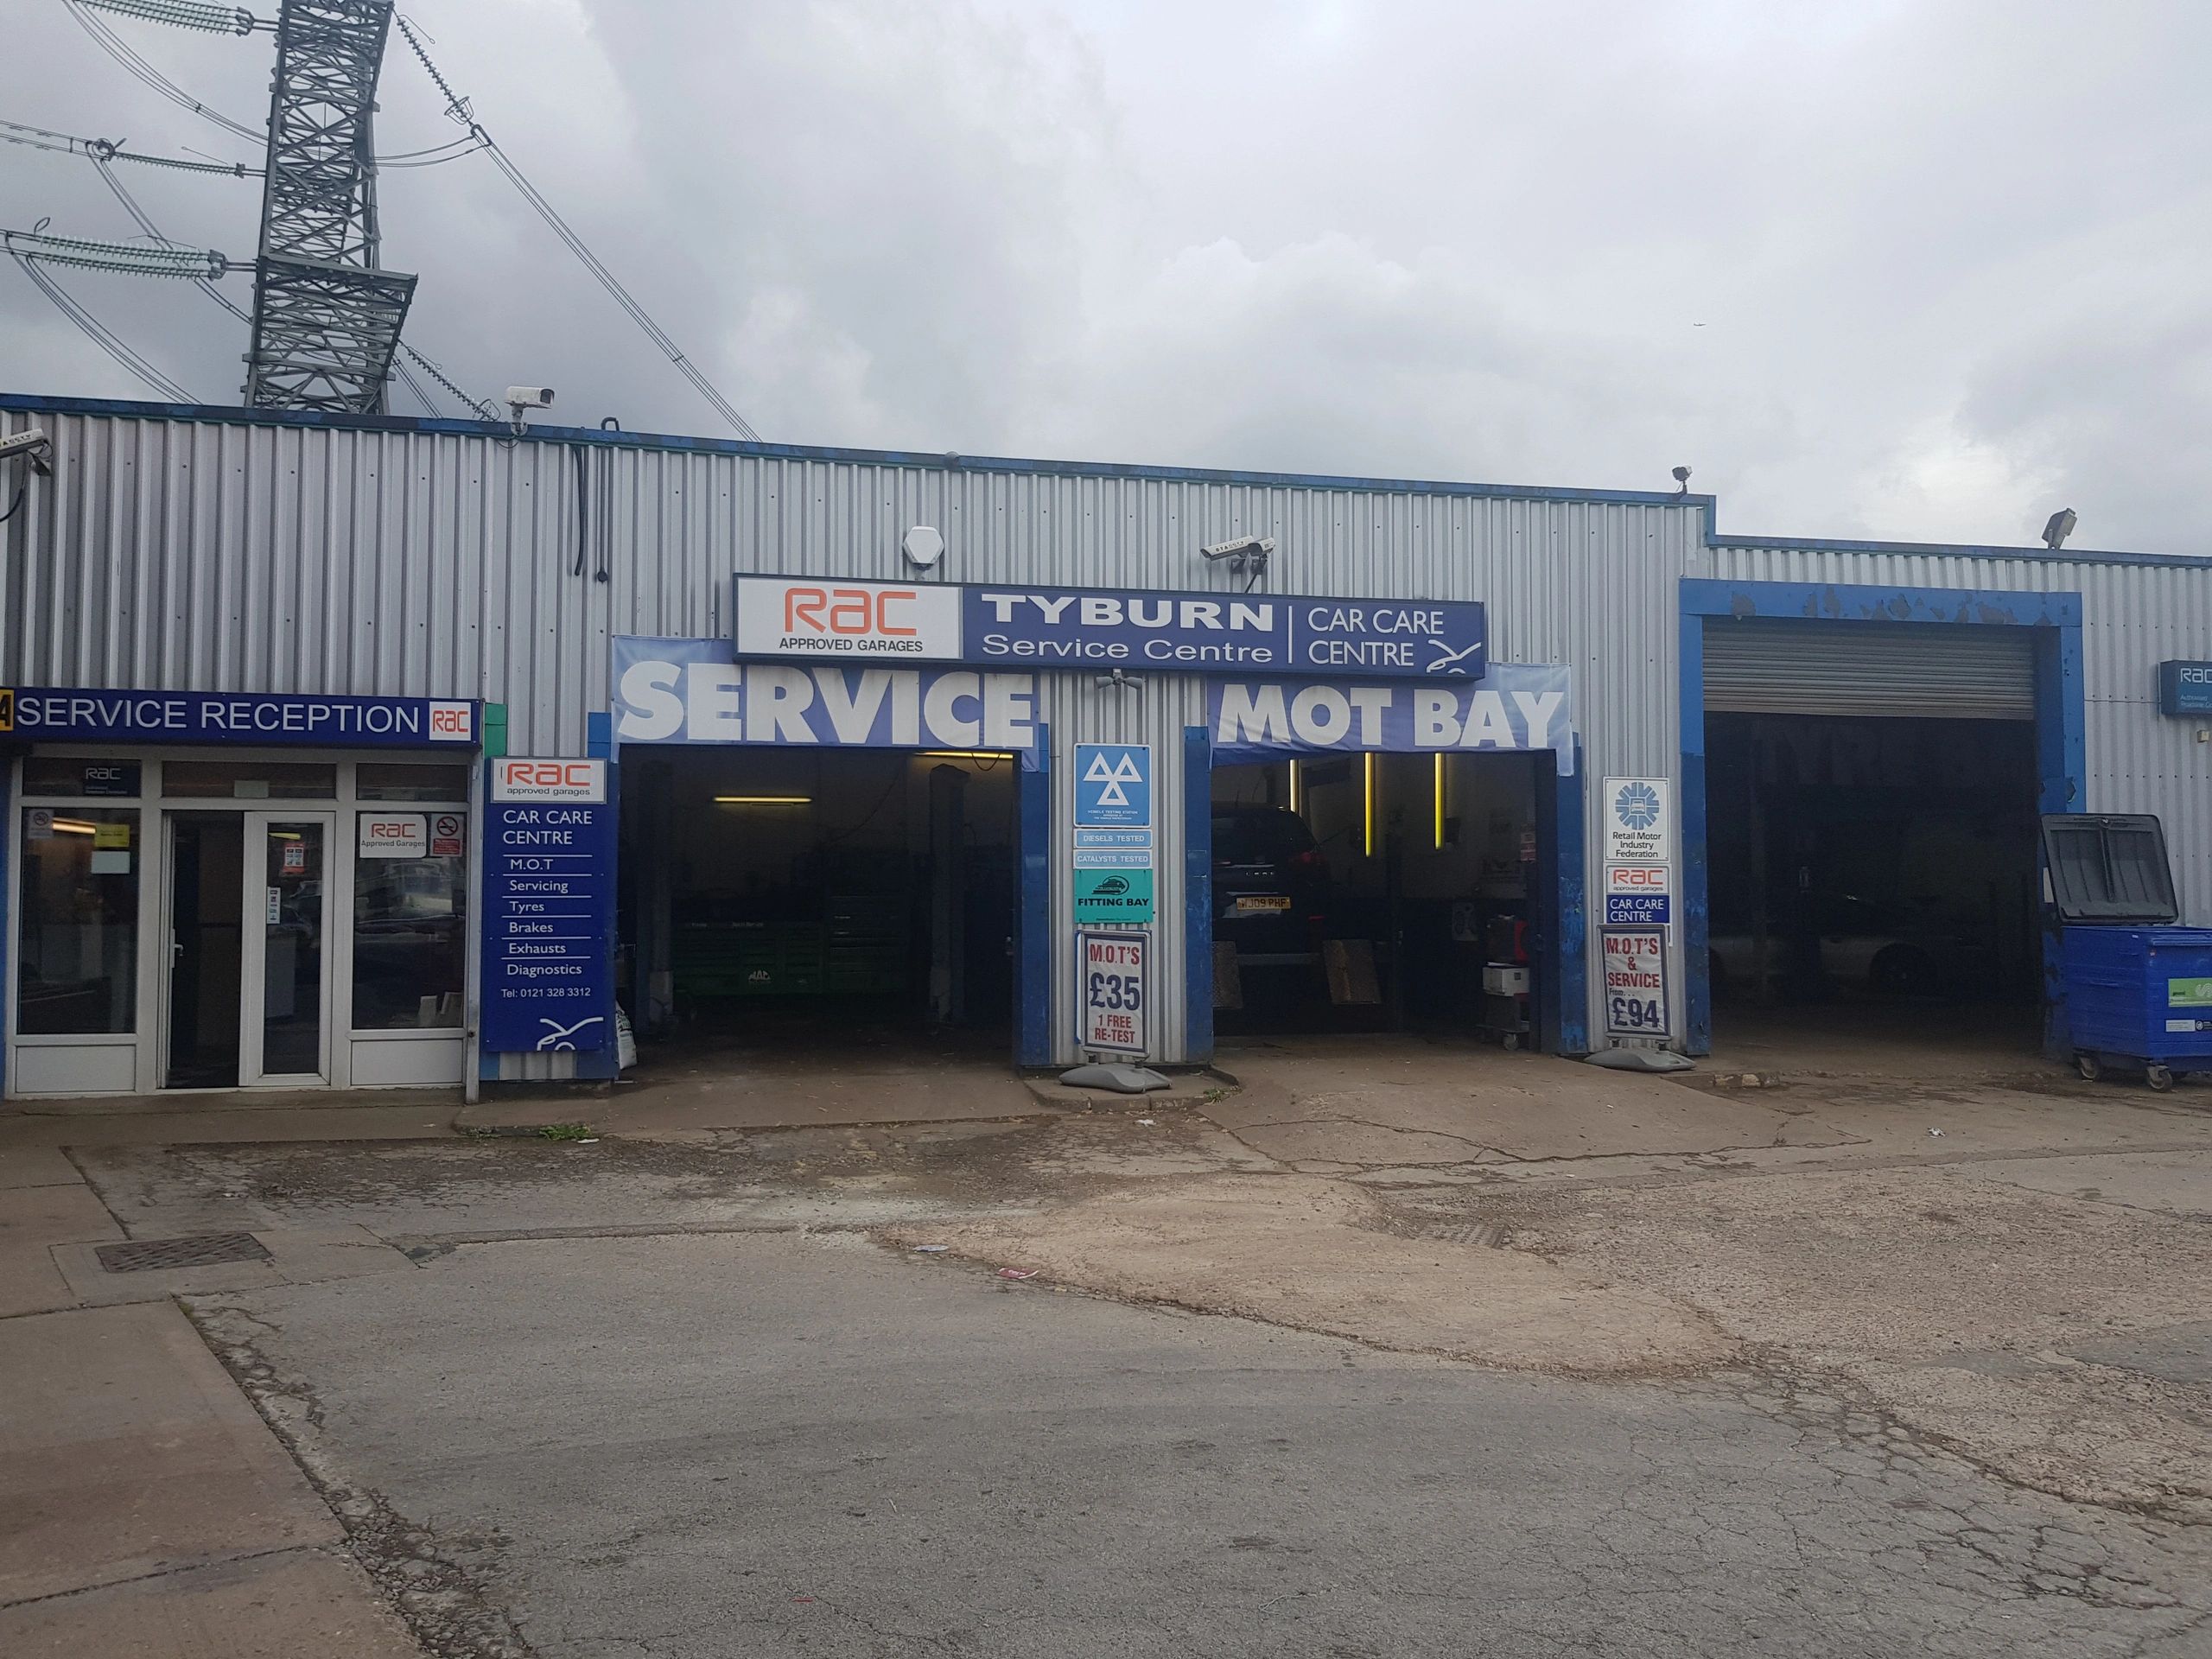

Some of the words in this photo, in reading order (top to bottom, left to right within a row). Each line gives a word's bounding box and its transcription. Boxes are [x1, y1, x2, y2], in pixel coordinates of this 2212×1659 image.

[982, 594, 1273, 632] TYBURN
[1308, 607, 1367, 632] CAR
[1372, 609, 1444, 634] CARE
[779, 638, 853, 651] APPROVED
[857, 639, 924, 652] GARAGES
[982, 634, 1129, 658] Service
[1144, 639, 1273, 663] Centre
[1308, 640, 1414, 666] CENTRE
[618, 660, 1034, 748] SERVICE
[16, 697, 188, 728] SERVICE
[200, 701, 419, 734] RECEPTION
[1217, 683, 1392, 747] MOT
[1414, 690, 1564, 748] BAY
[503, 810, 541, 823] CAR
[546, 810, 593, 824] CARE
[503, 830, 573, 844] CENTRE
[1612, 831, 1636, 840] Retail
[1637, 832, 1662, 841] Motor
[396, 840, 426, 849] Garages
[1620, 841, 1654, 850] Industry
[510, 859, 554, 870] M.O.T
[510, 880, 569, 893] Servicing
[509, 901, 545, 914] Tyres
[1610, 899, 1633, 909] CAR
[1636, 899, 1664, 909] CARE
[1610, 911, 1653, 922] CENTRE
[509, 921, 554, 933] Brakes
[509, 943, 567, 954] Exhausts
[1605, 938, 1658, 955] M.O.T'S
[1090, 944, 1140, 965] M.O.T'S
[1627, 957, 1637, 970] &
[507, 964, 582, 978] Diagnostics
[1608, 972, 1661, 988] SERVICE
[501, 988, 518, 998] Tel:
[520, 988, 543, 997] 0121
[547, 988, 565, 997] 328
[567, 988, 591, 996] 3312
[1090, 972, 1141, 1010] £35
[1612, 997, 1659, 1027] £94
[1098, 1014, 1103, 1027] 1
[1107, 1014, 1132, 1028] FREE
[1094, 1027, 1135, 1044] RE-TEST
